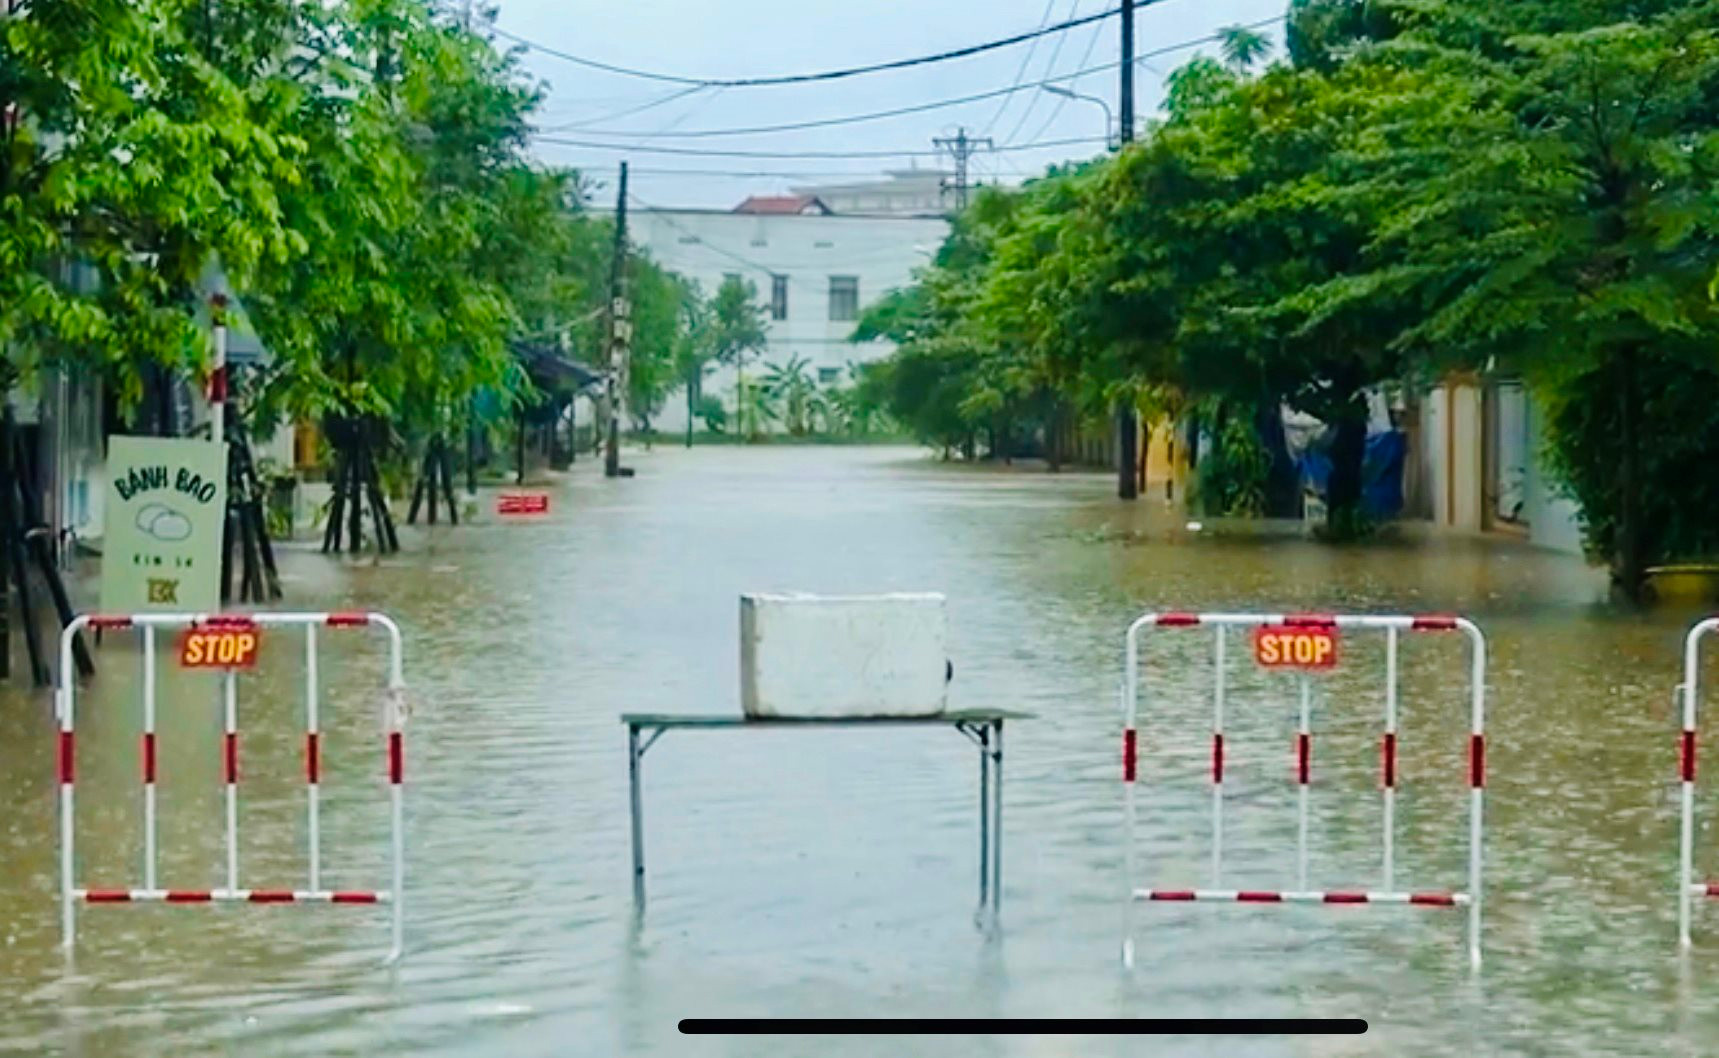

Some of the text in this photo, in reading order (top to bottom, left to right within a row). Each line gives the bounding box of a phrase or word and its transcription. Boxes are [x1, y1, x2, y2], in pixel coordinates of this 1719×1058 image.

[176, 467, 216, 504] BAO
[185, 633, 255, 663] STOP
[1260, 633, 1332, 664] STOP
